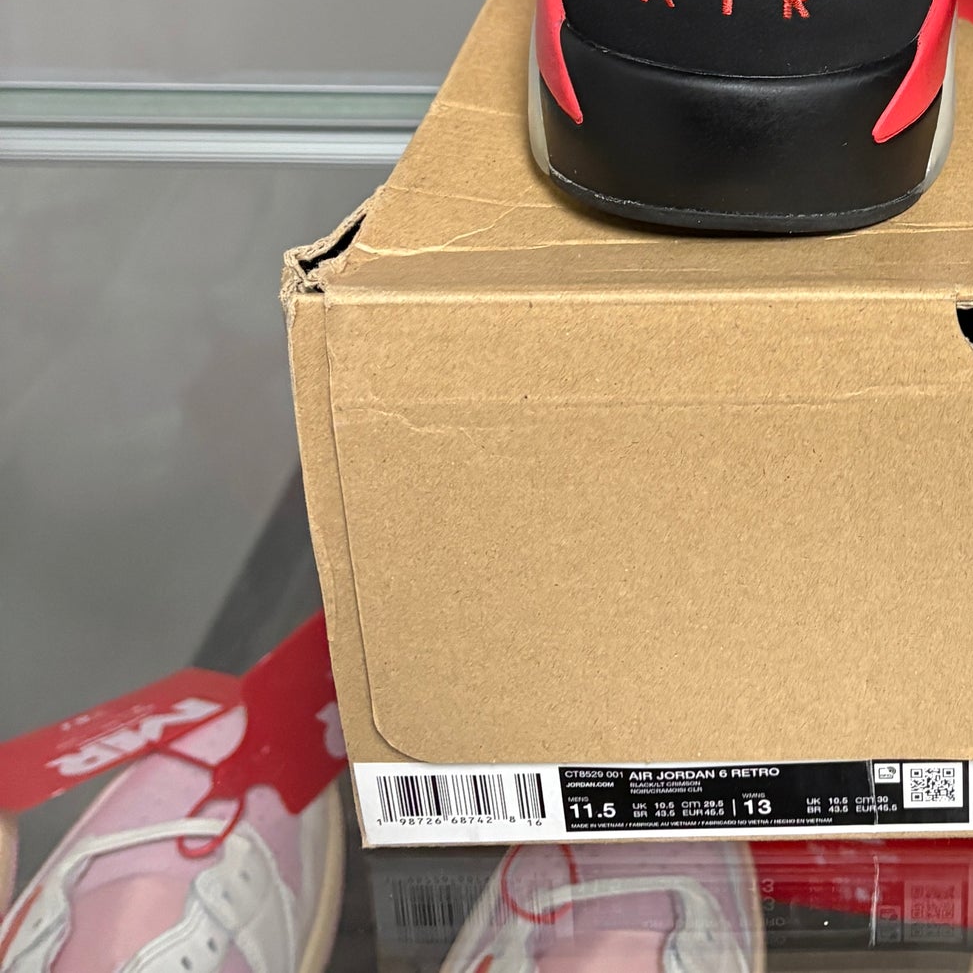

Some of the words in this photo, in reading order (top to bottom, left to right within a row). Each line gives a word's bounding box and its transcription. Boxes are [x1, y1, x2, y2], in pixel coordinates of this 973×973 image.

[565, 770, 603, 779] CT8529
[606, 770, 624, 779] 001
[629, 771, 653, 781] AIR
[656, 770, 715, 780] JORDAN
[719, 770, 727, 778] 6
[731, 767, 780, 778] RETRO
[829, 797, 848, 805] 10.5
[569, 803, 616, 818] 11.5
[744, 799, 772, 815] 13
[807, 806, 821, 814] BR
[856, 805, 876, 813] EUR
[655, 810, 675, 818] 43.5
[682, 809, 703, 817] EUR
[400, 817, 442, 826] 98726
[451, 816, 493, 825] 68742
[528, 819, 543, 827] 16
